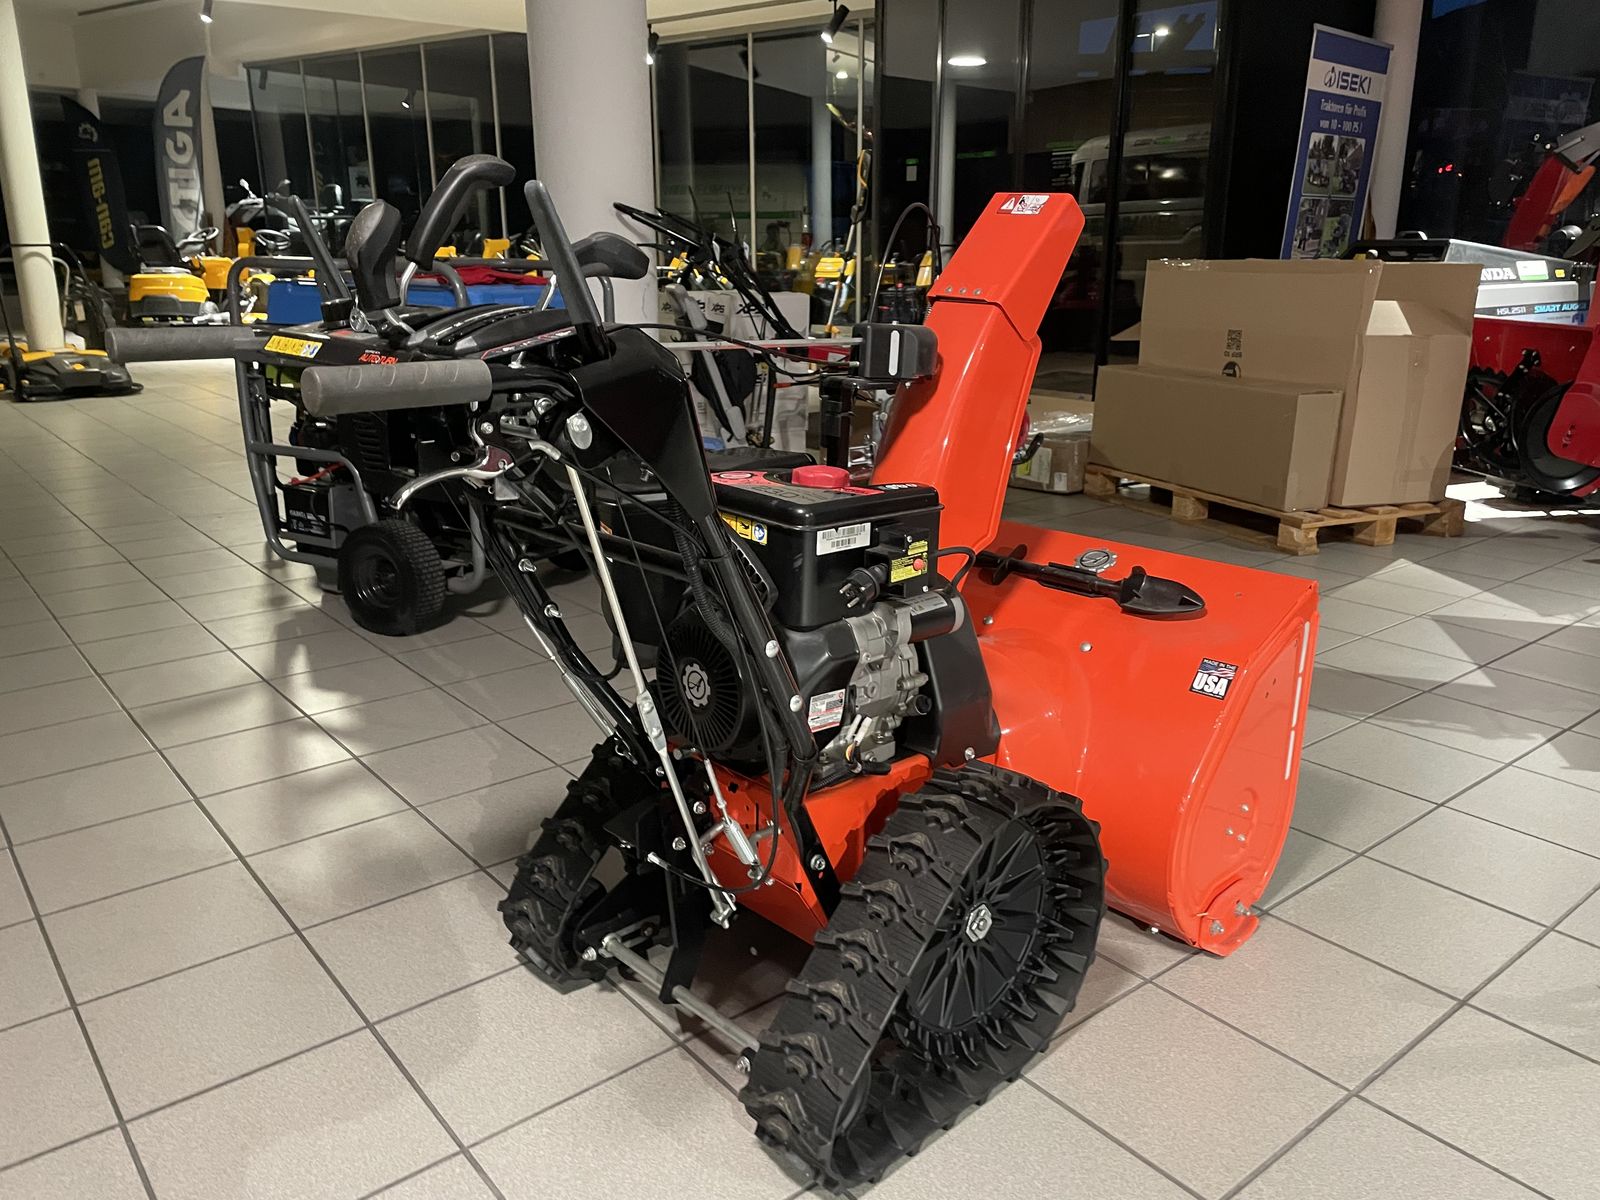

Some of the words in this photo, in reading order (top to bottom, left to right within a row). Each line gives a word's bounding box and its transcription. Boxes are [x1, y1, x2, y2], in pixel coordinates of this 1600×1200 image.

[1336, 71, 1371, 94] ISEKI
[1481, 268, 1517, 280] NDA
[1534, 304, 1561, 314] SMART
[1192, 672, 1229, 696] USA
